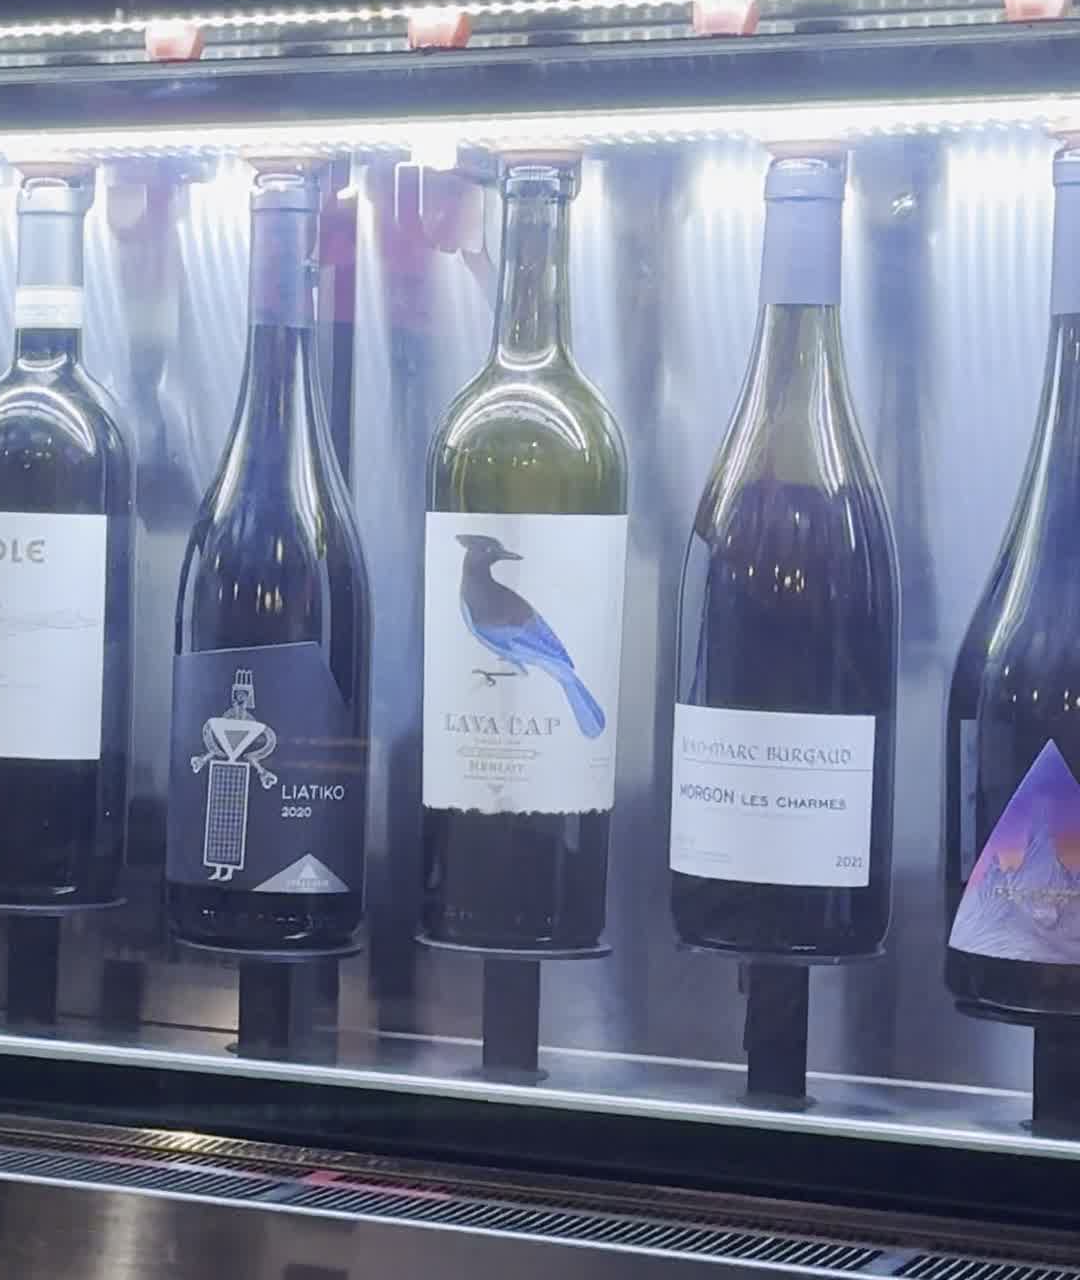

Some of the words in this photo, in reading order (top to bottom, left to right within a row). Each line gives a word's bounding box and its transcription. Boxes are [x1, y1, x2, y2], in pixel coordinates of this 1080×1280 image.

[443, 712, 501, 736] LAVA
[507, 714, 561, 737] CAP
[766, 744, 853, 766] BURGAUD
[281, 784, 346, 801] LIATIKO
[679, 783, 736, 806] MORGON
[740, 794, 769, 808] LES
[775, 796, 848, 811] CHARMES
[281, 805, 313, 819] 2020
